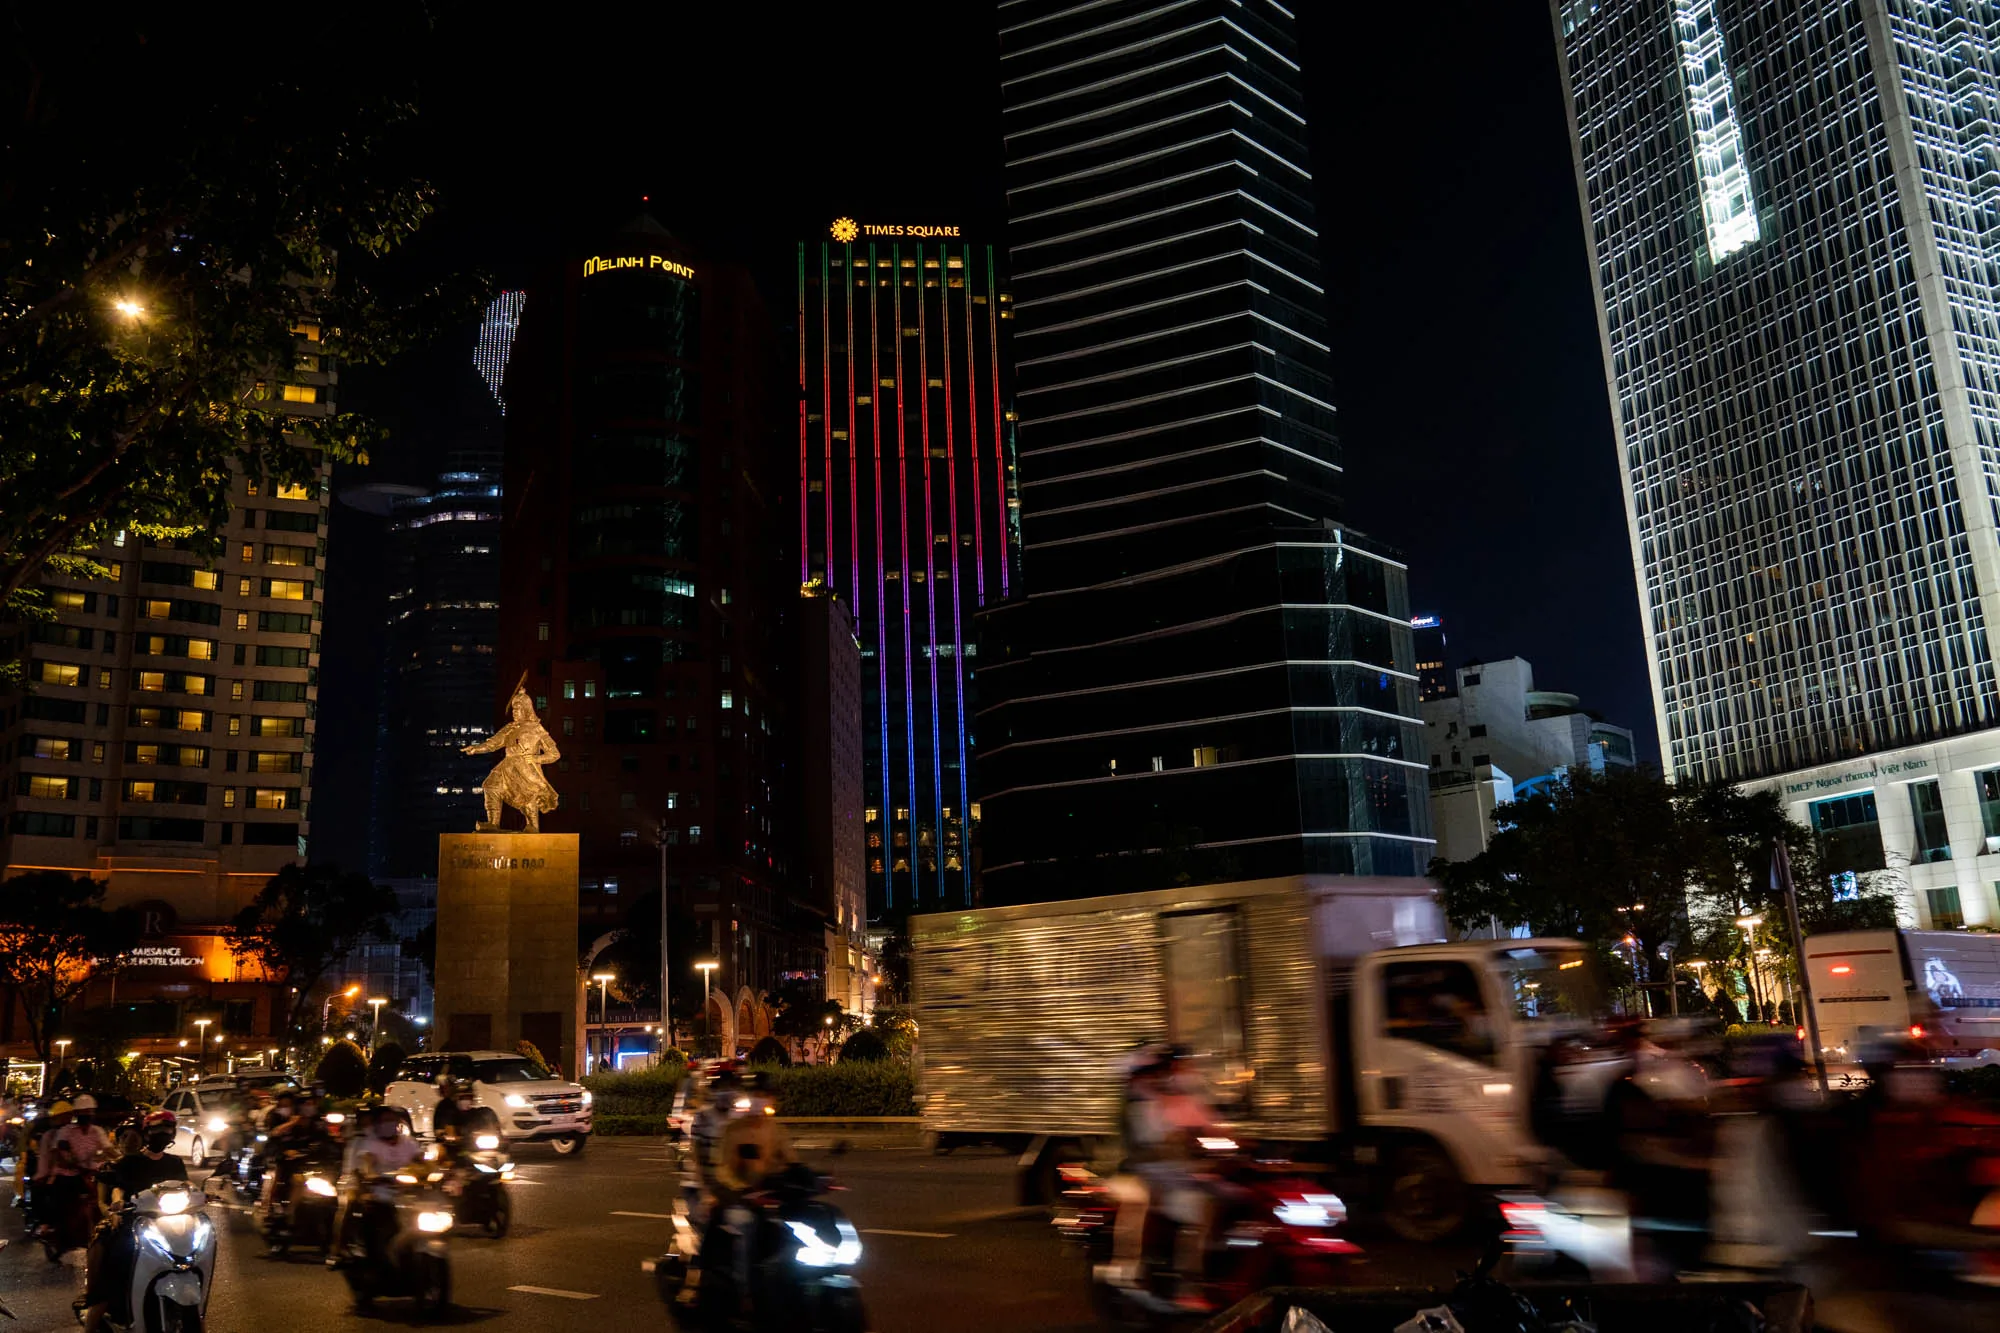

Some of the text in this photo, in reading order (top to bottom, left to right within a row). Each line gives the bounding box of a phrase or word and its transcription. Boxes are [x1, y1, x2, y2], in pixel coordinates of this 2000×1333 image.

[863, 225, 960, 237] TIMES SQUARE
[649, 254, 695, 280] POINT
[1903, 759, 1928, 772] Nam
[138, 957, 168, 967] HOTEL
[169, 957, 205, 967] SAIGON
